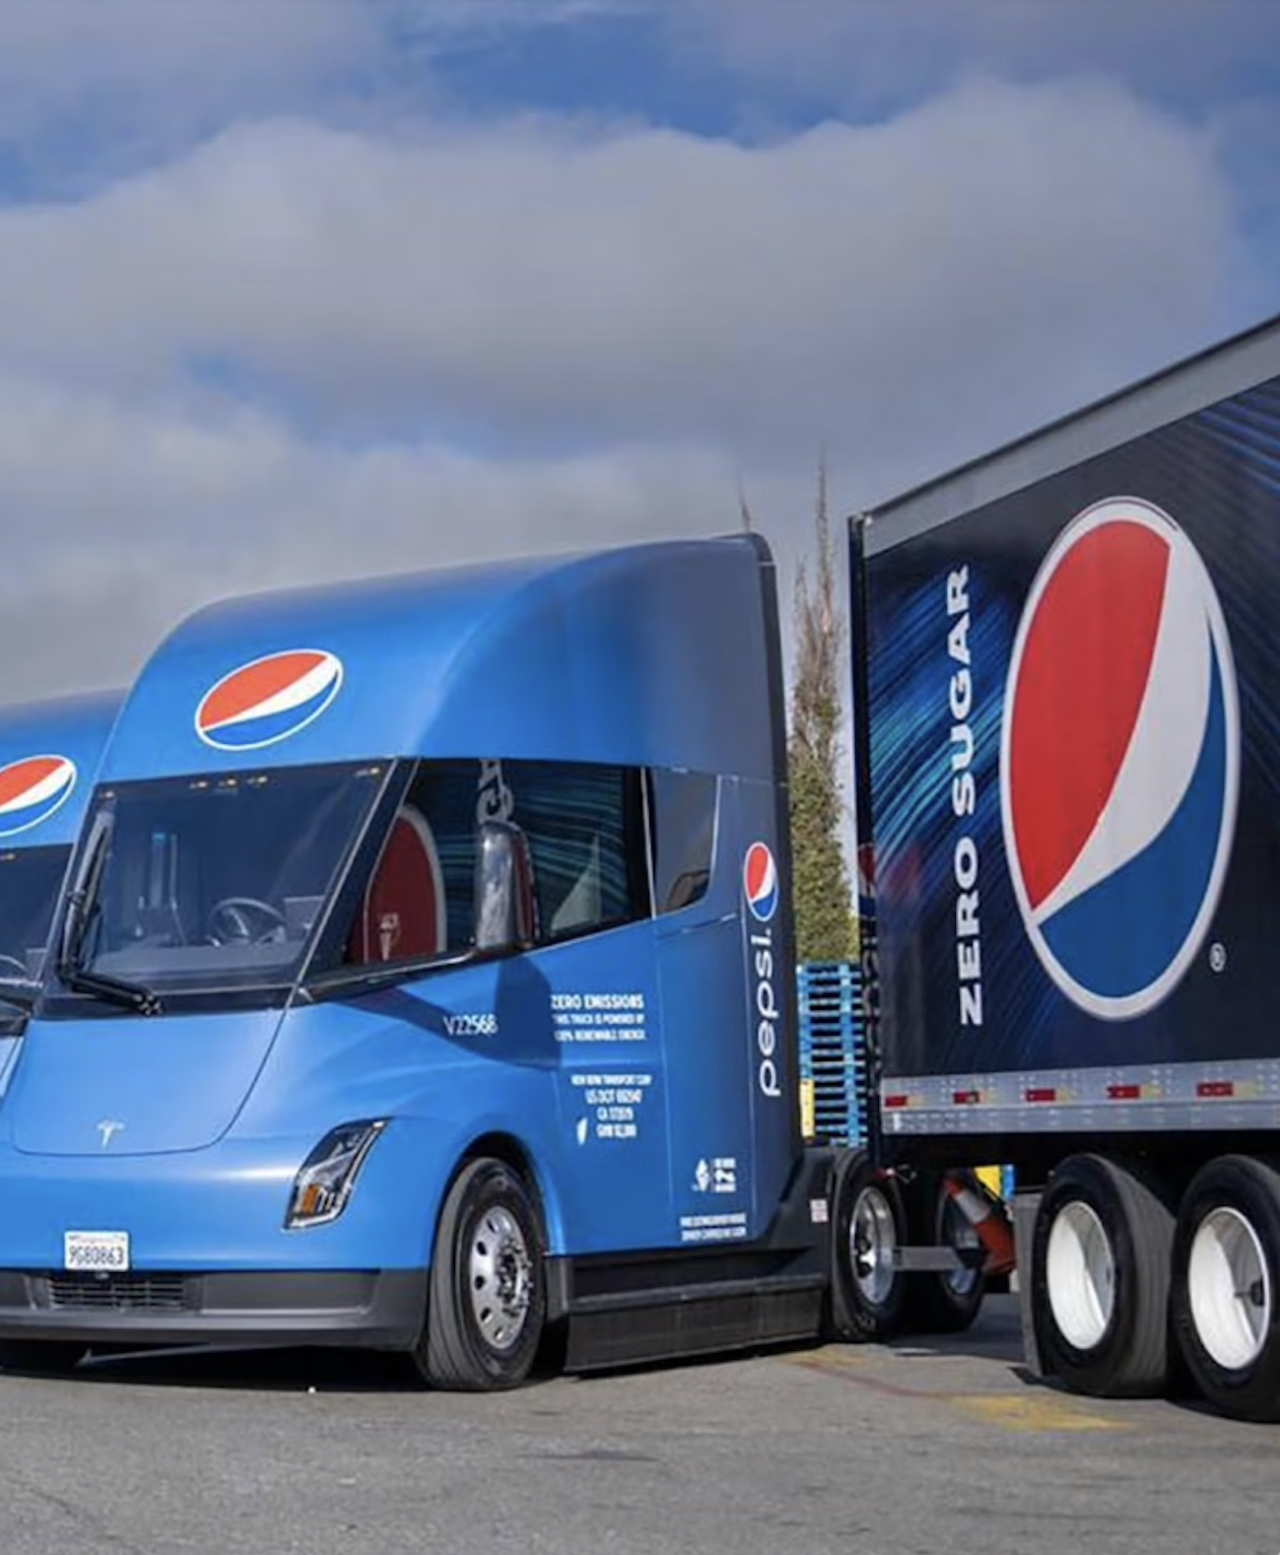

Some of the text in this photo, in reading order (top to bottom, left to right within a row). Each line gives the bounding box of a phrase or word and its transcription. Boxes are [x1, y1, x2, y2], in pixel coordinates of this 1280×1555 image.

[946, 564, 984, 1027] ZERO SUGAR
[550, 993, 645, 1010] ZERO EMISSIONS
[751, 933, 782, 1097] pepsi
